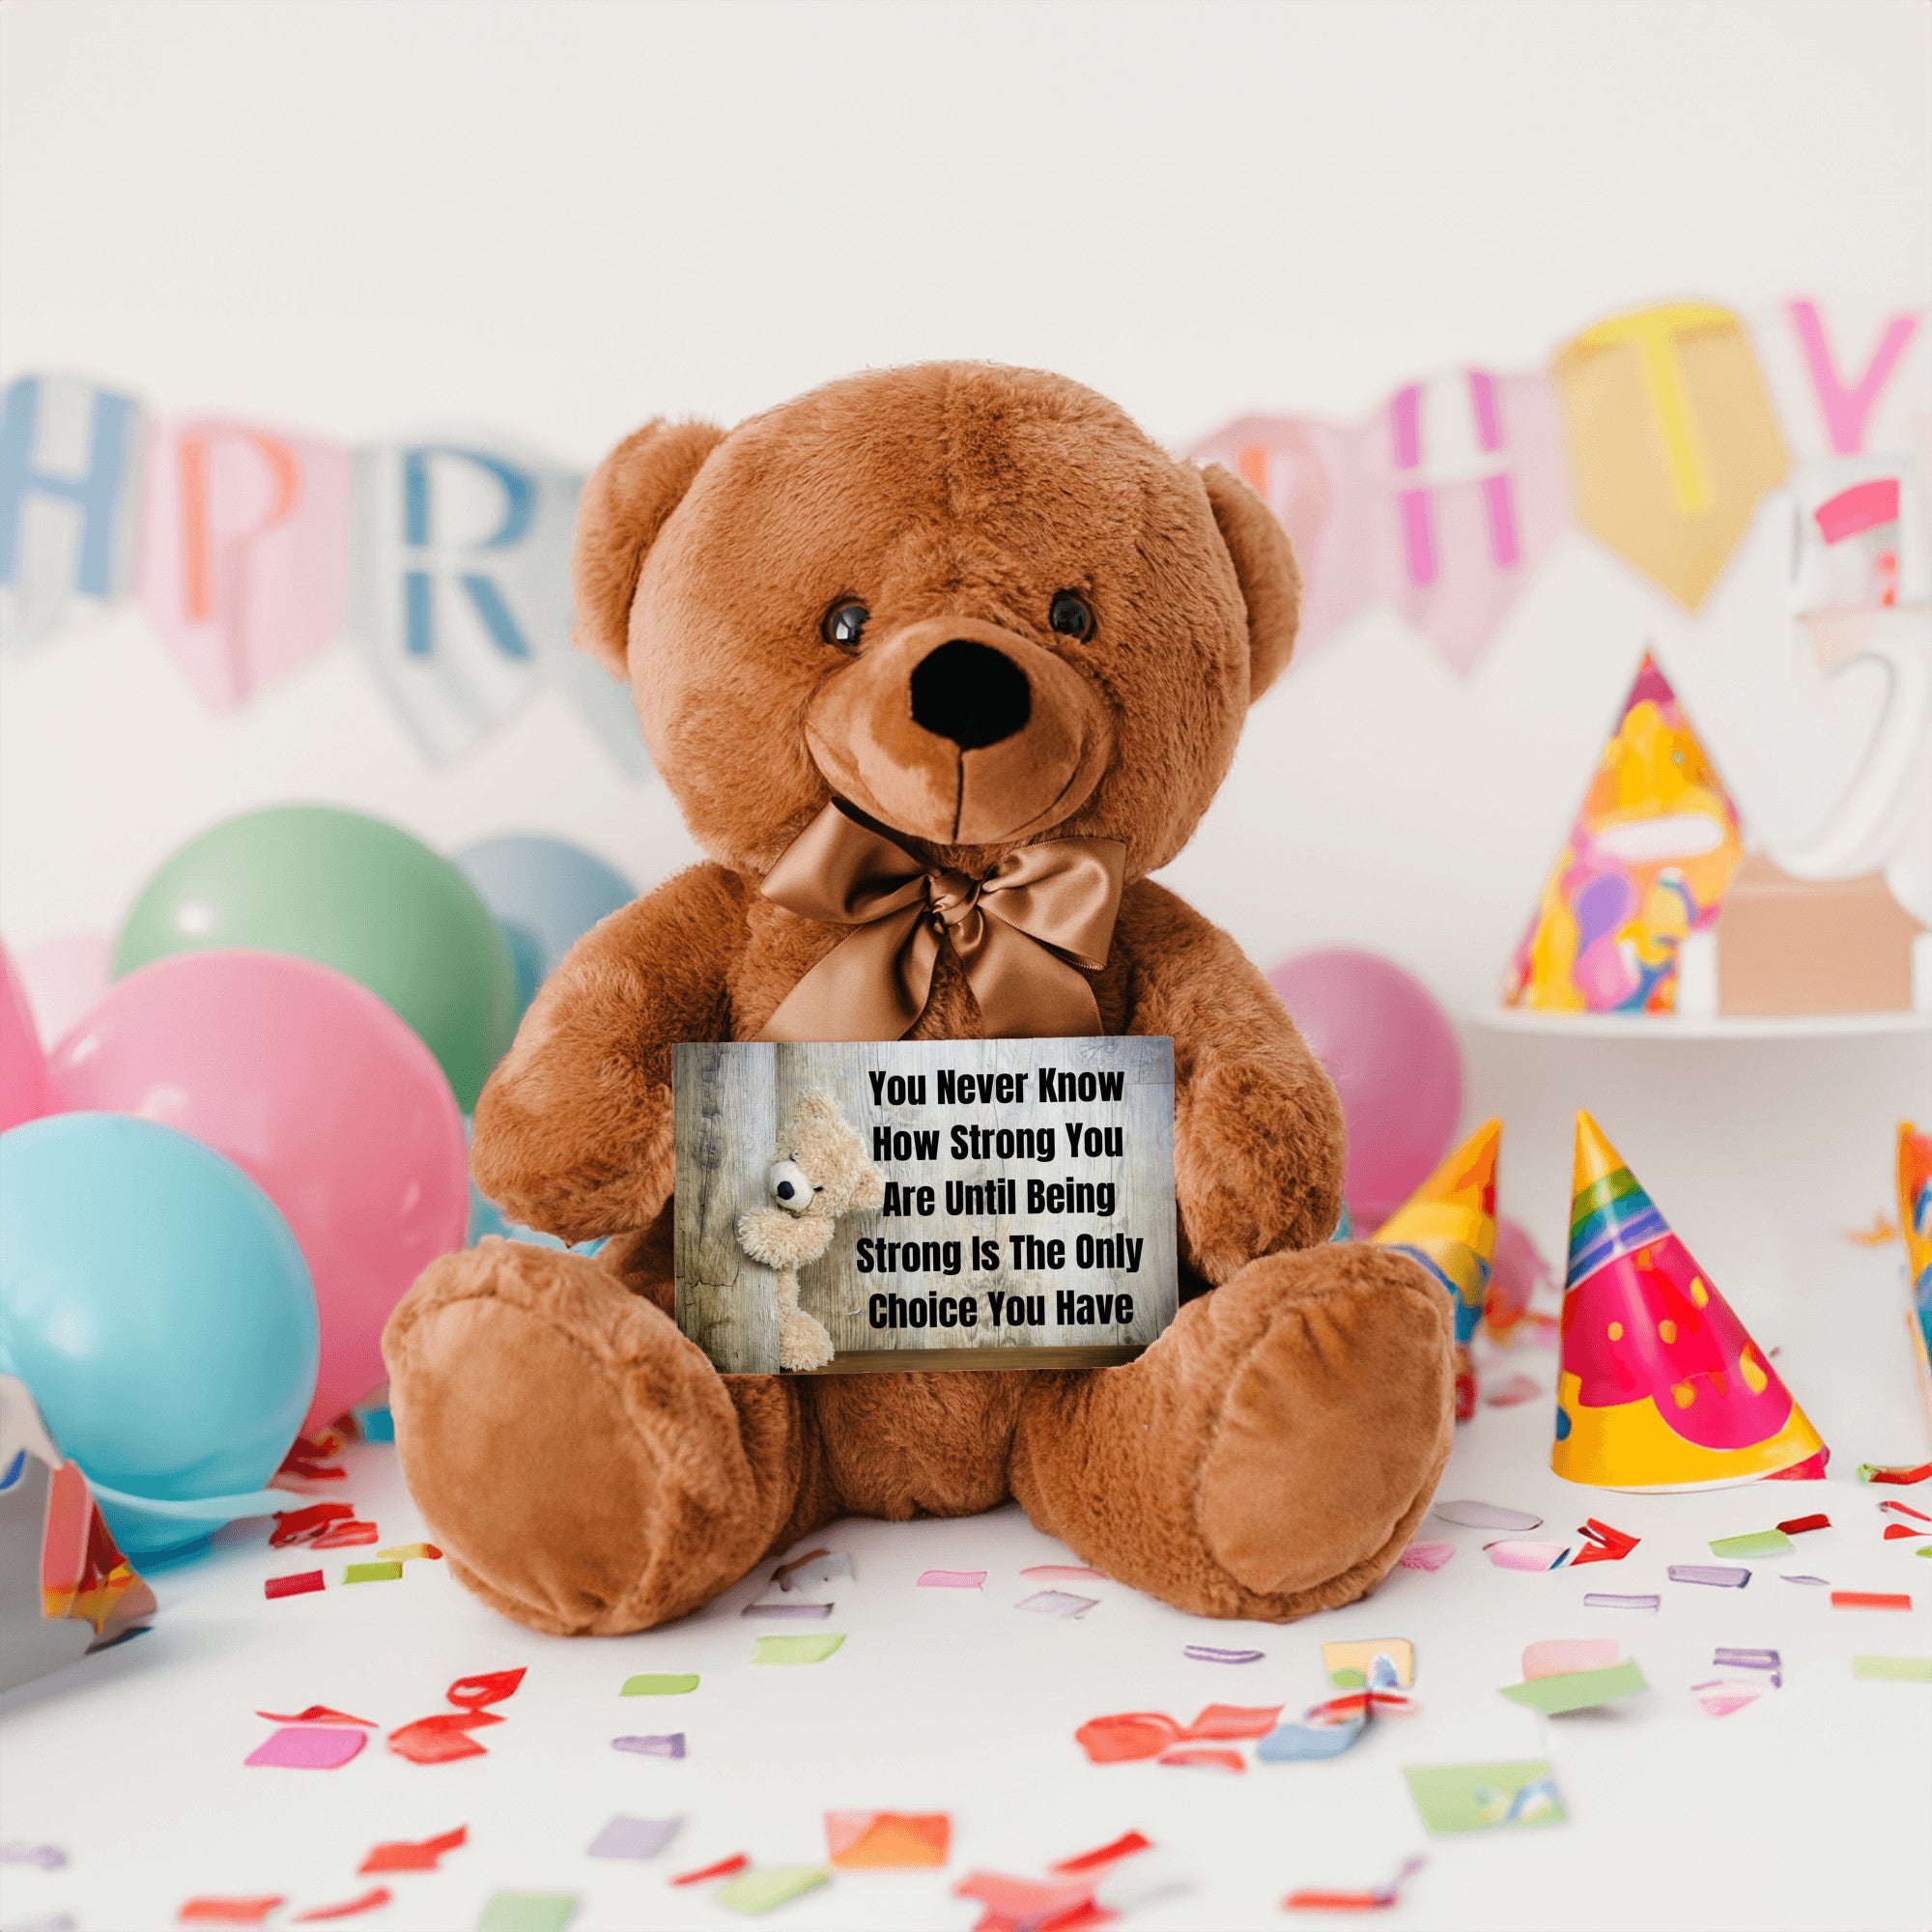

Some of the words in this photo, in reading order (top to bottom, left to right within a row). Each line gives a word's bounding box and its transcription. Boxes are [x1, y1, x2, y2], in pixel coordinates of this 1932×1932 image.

[868, 1069, 926, 1107] You
[937, 1068, 1030, 1106] Never
[1038, 1067, 1125, 1104] Know
[872, 1125, 940, 1162] How
[950, 1124, 1056, 1163] Strong
[1065, 1122, 1123, 1158] You
[882, 1181, 935, 1217] Are
[945, 1179, 1017, 1216] Until
[1027, 1178, 1116, 1217] Being
[856, 1237, 961, 1277] Strong
[972, 1236, 1000, 1271] Is
[1009, 1235, 1065, 1271] The
[1075, 1233, 1144, 1273] Only
[868, 1291, 978, 1329] Choice
[986, 1291, 1045, 1327] You
[1056, 1290, 1134, 1326] Have
